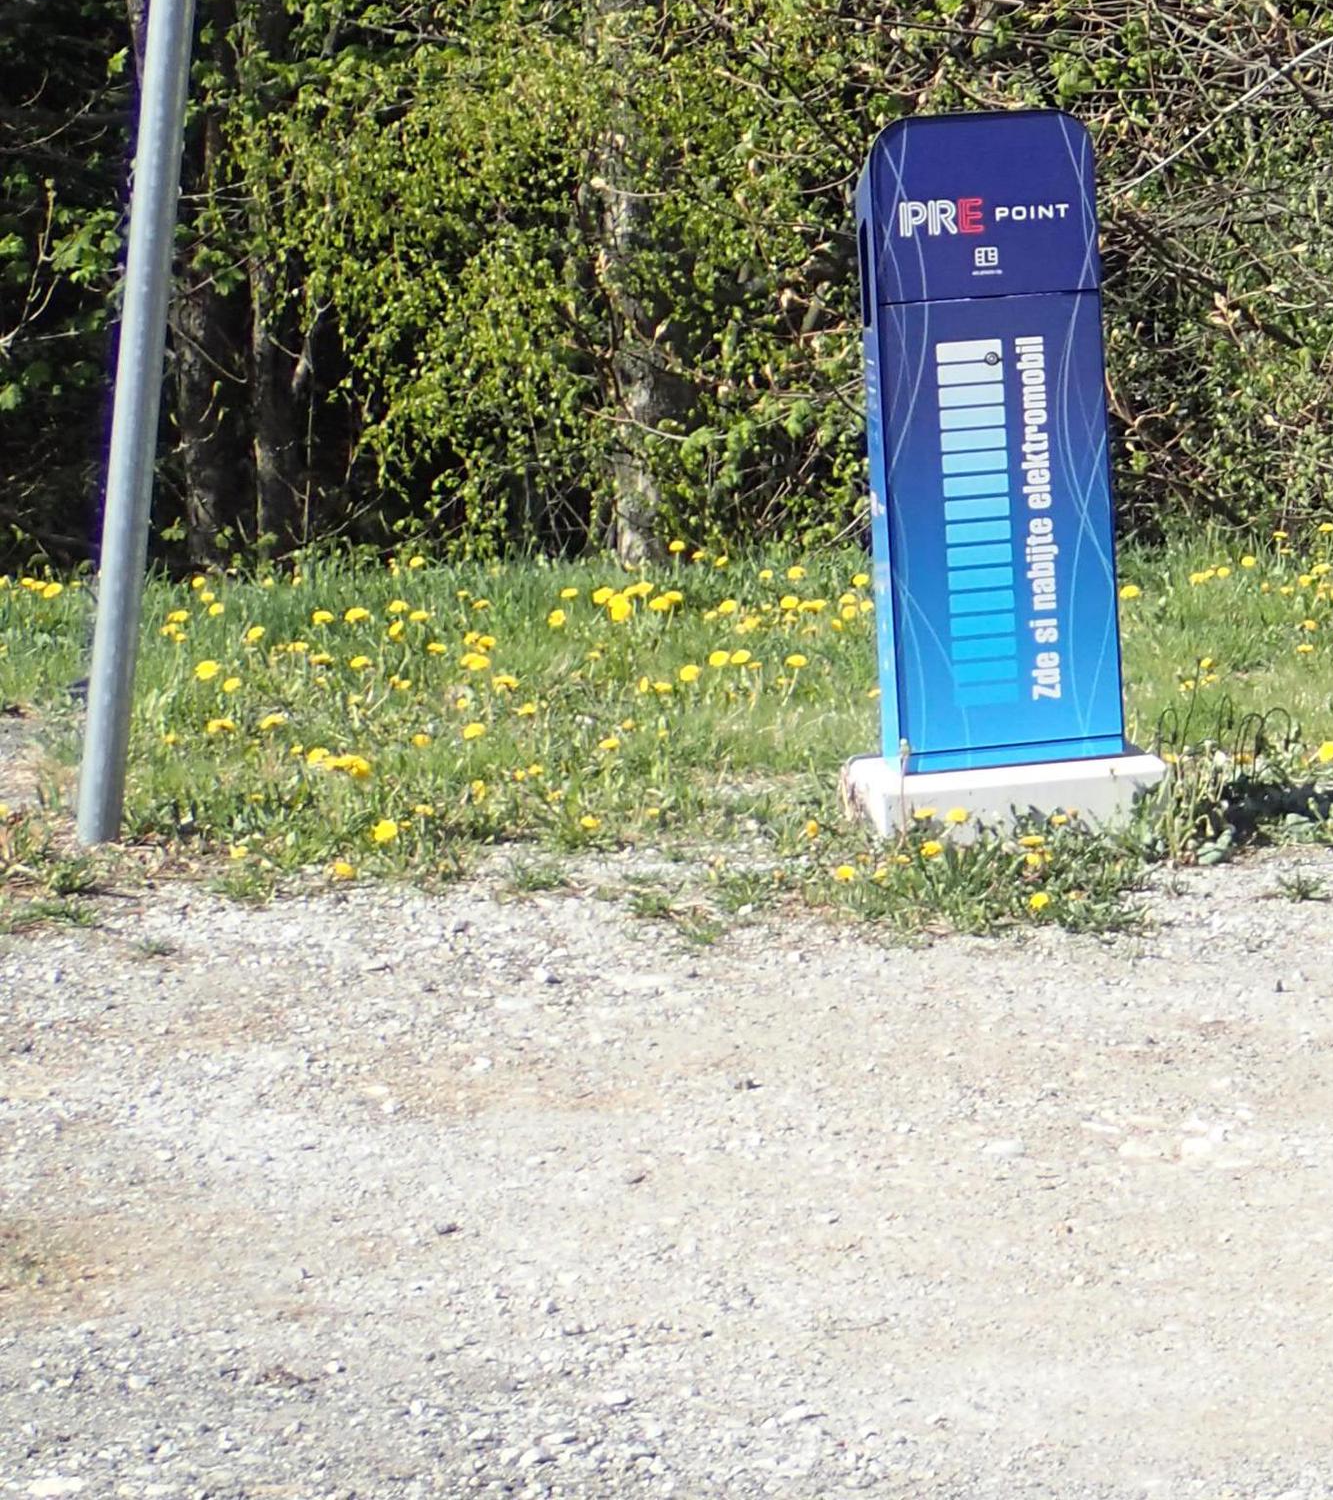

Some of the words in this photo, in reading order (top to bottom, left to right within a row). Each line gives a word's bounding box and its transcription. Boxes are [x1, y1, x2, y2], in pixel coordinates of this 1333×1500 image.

[899, 198, 985, 237] PRE
[995, 203, 1069, 221] POINT
[1015, 336, 1052, 510] elektromobil
[1025, 517, 1059, 611] nabijte
[1029, 618, 1059, 644] si
[1032, 651, 1062, 701] Zde
